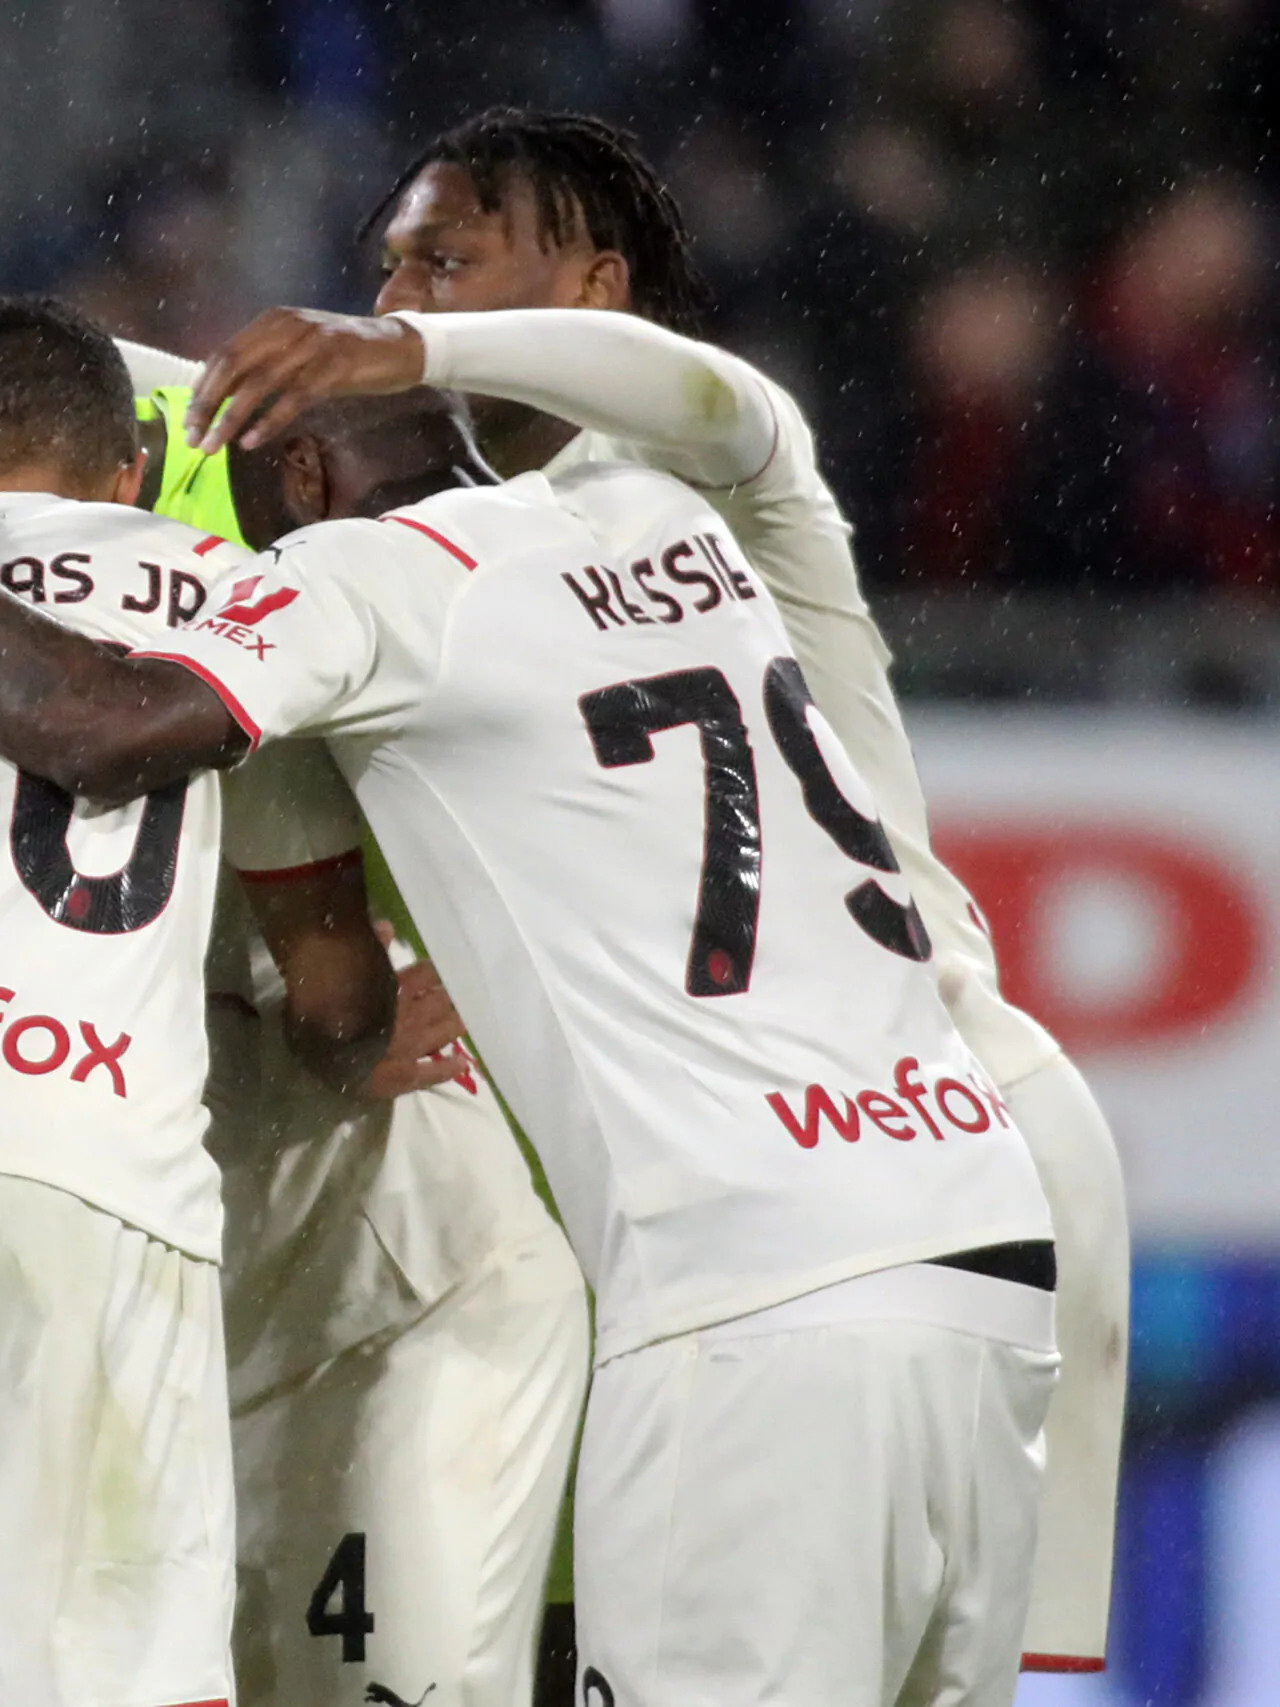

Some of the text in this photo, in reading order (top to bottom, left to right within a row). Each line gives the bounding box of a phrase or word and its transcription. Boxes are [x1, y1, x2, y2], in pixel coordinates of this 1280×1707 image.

[560, 533, 758, 631] KESSIE
[578, 657, 933, 998] 79
[764, 1056, 1010, 1149] wefox
[307, 1532, 374, 1662] 4
